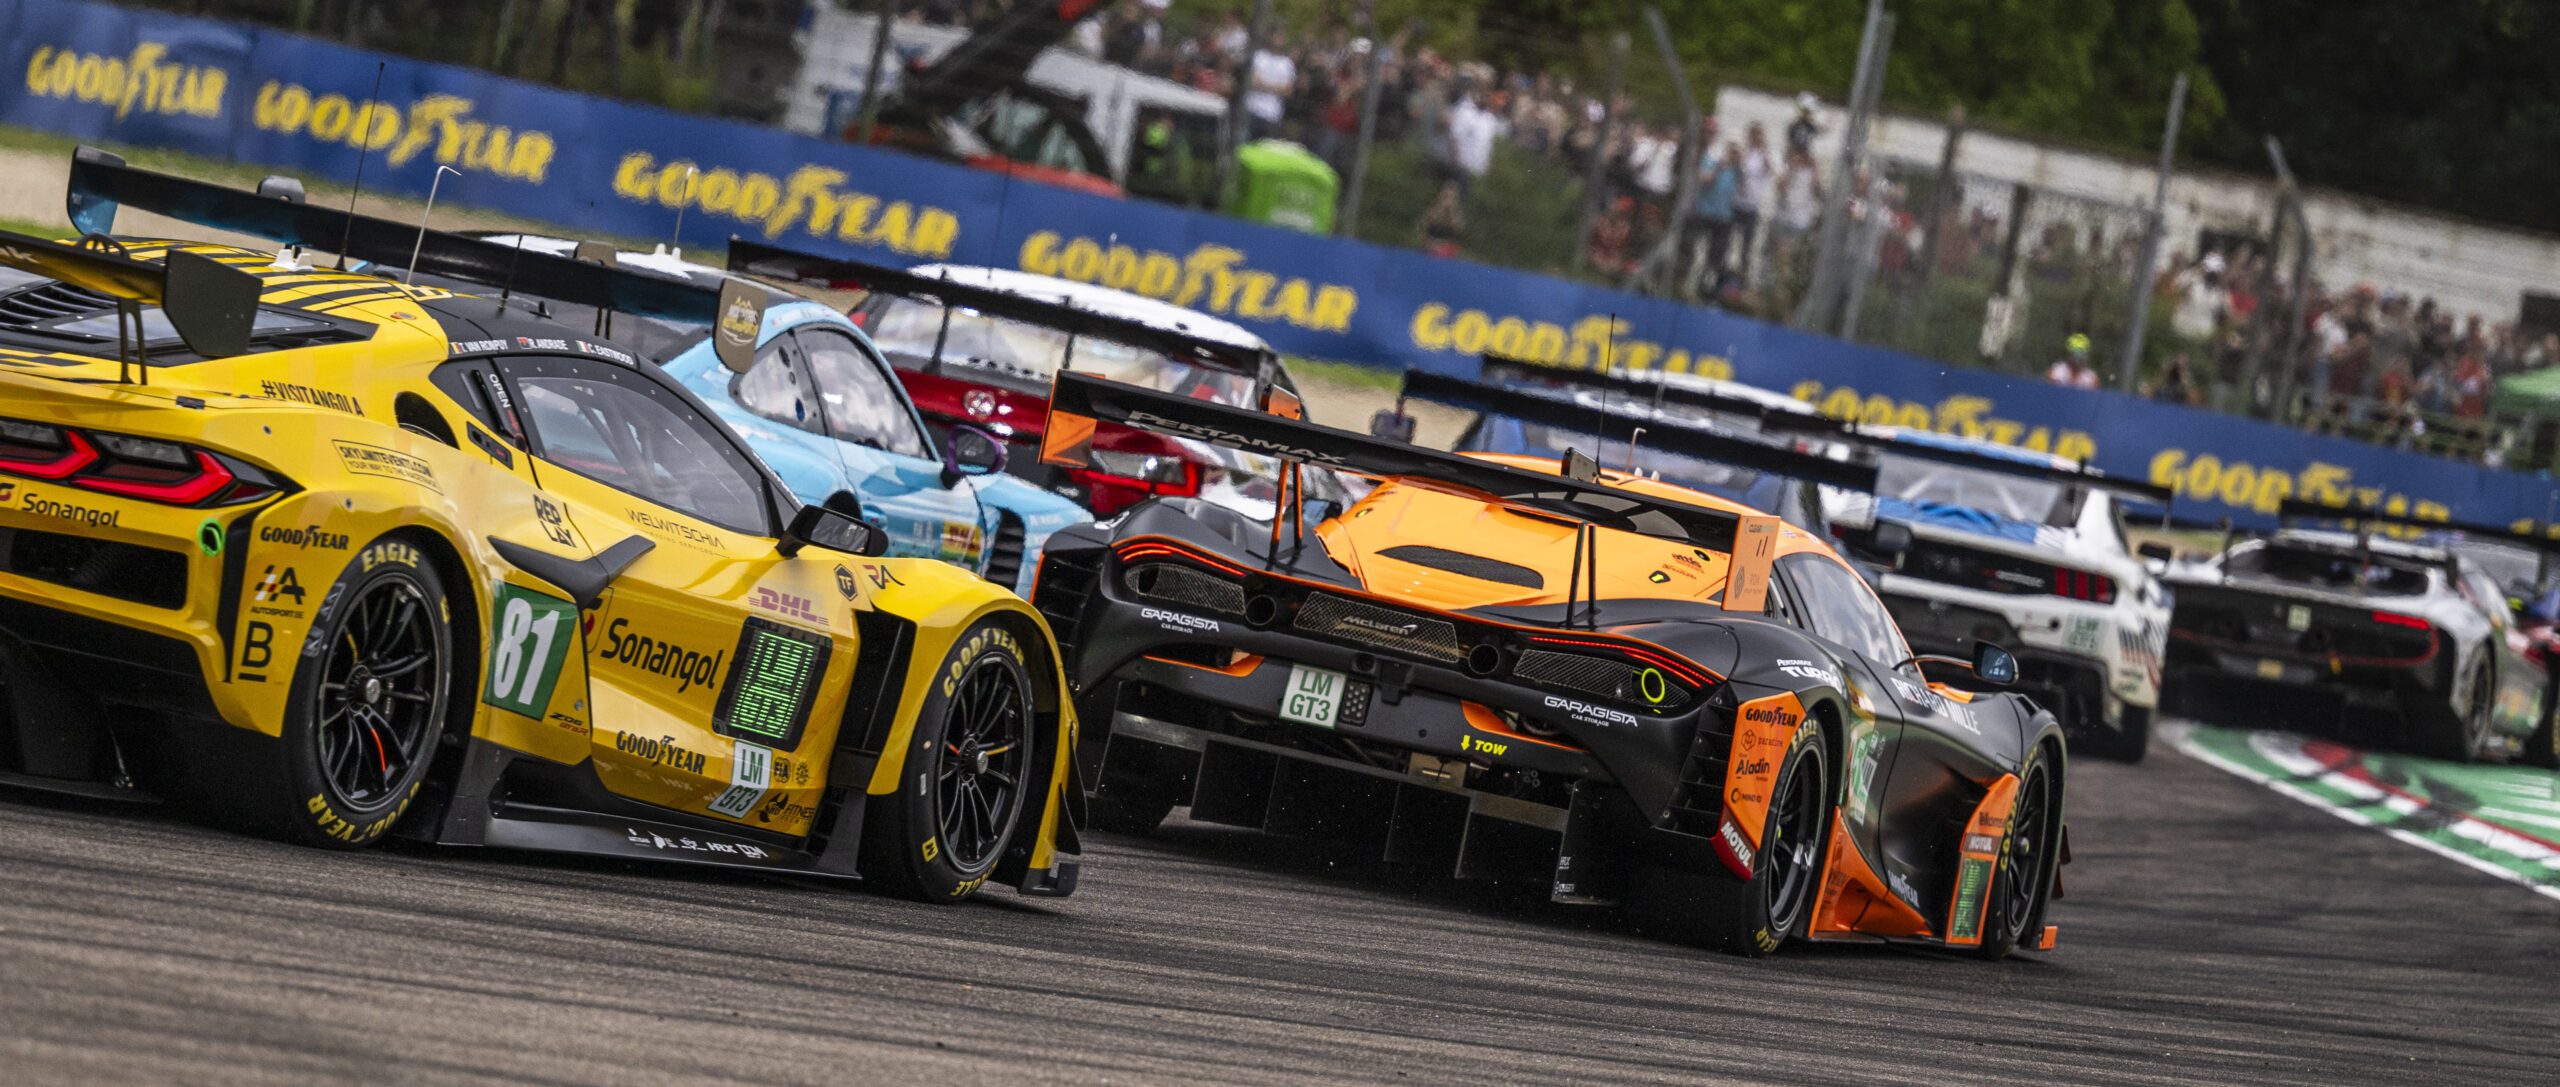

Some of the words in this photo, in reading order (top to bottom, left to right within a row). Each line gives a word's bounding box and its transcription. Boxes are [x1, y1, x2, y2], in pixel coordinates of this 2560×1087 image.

[26, 41, 228, 121] GOODYEAR
[254, 79, 556, 184] GOODYEAR
[612, 150, 959, 260] GOODYEAR
[1019, 229, 1358, 333] GOODYEAR
[596, 345, 634, 366] EASTWOOD
[260, 379, 365, 418] #VISITANGOLA
[489, 373, 511, 409] OPEN
[1127, 410, 1346, 465] PERTAMAX
[22, 492, 121, 528] Sonangol
[533, 494, 562, 525] REP
[260, 525, 349, 550] GOODYEAR
[540, 519, 577, 548] LAY
[625, 508, 726, 551] WELWITSCHIA
[361, 541, 423, 573] EAGLE
[757, 586, 821, 624] DHL
[1141, 607, 1220, 632] GARAGISTA
[1343, 615, 1419, 636] McLaren
[493, 597, 561, 706] 81
[601, 617, 725, 694] Sonangol
[943, 627, 1025, 699] GOODYEAR
[1299, 671, 1333, 698] LM
[1288, 695, 1332, 722] GT3
[1544, 695, 1639, 728] GARAGISTA
[1571, 713, 1584, 722] CAR
[1583, 716, 1610, 727] STORAGE
[1745, 706, 1798, 729] GOODYEAR
[1890, 677, 1949, 719] RICHARD
[1943, 697, 1983, 737] MILLE
[616, 730, 706, 776] GOODYEAR
[1474, 739, 1508, 756] TOW
[1792, 718, 1818, 754] EAGLE
[740, 748, 764, 785] LM
[1736, 757, 1770, 776] Aladin
[718, 784, 759, 813] GT3
[1720, 820, 1752, 868] MOTUL
[1969, 835, 1994, 853] MOTUL
